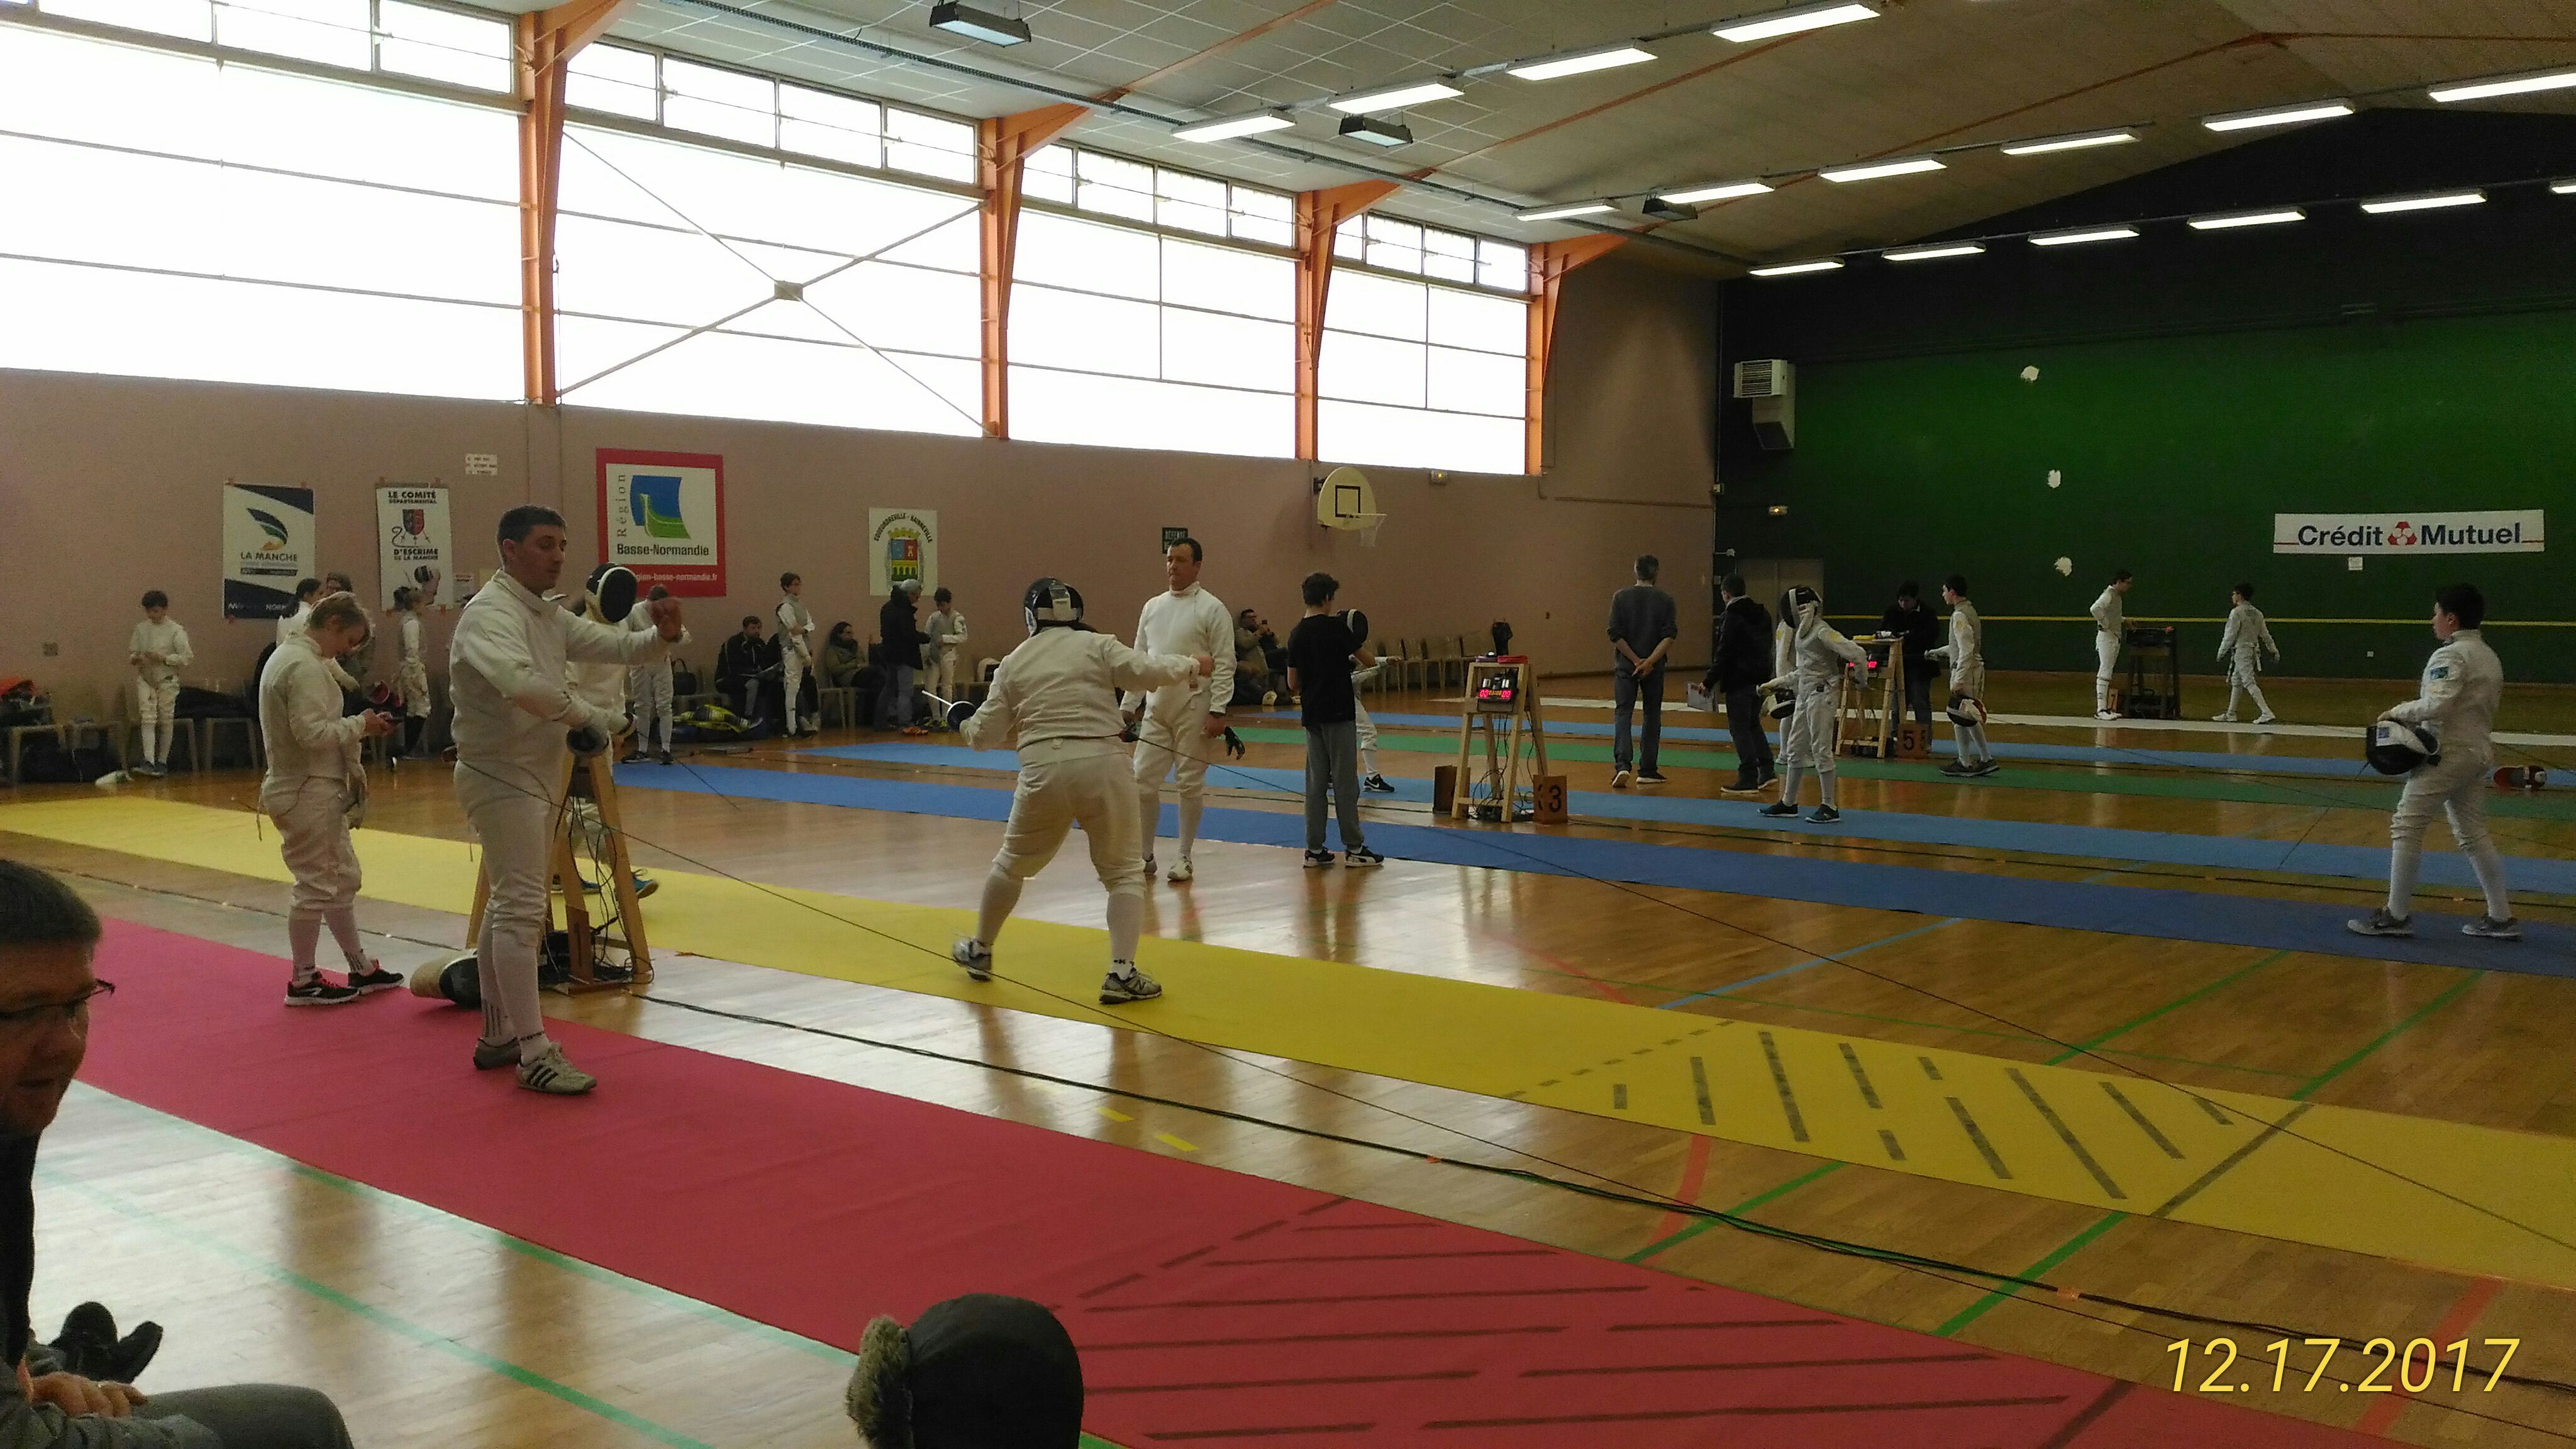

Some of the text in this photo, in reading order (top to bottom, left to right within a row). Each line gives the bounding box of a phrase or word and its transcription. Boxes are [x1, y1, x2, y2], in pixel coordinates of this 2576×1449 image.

[401, 490, 436, 499] COMITÉ
[615, 474, 629, 538] Région
[2297, 522, 2521, 546] Crédit Mutuel
[393, 548, 439, 556] D'ESCRIME
[616, 543, 709, 556] Basse-Normandie
[240, 552, 298, 562] LA MANCHE
[636, 573, 718, 582] gion-basse-normandie.fr
[1903, 730, 1914, 750] 5
[1549, 785, 1562, 813] 3
